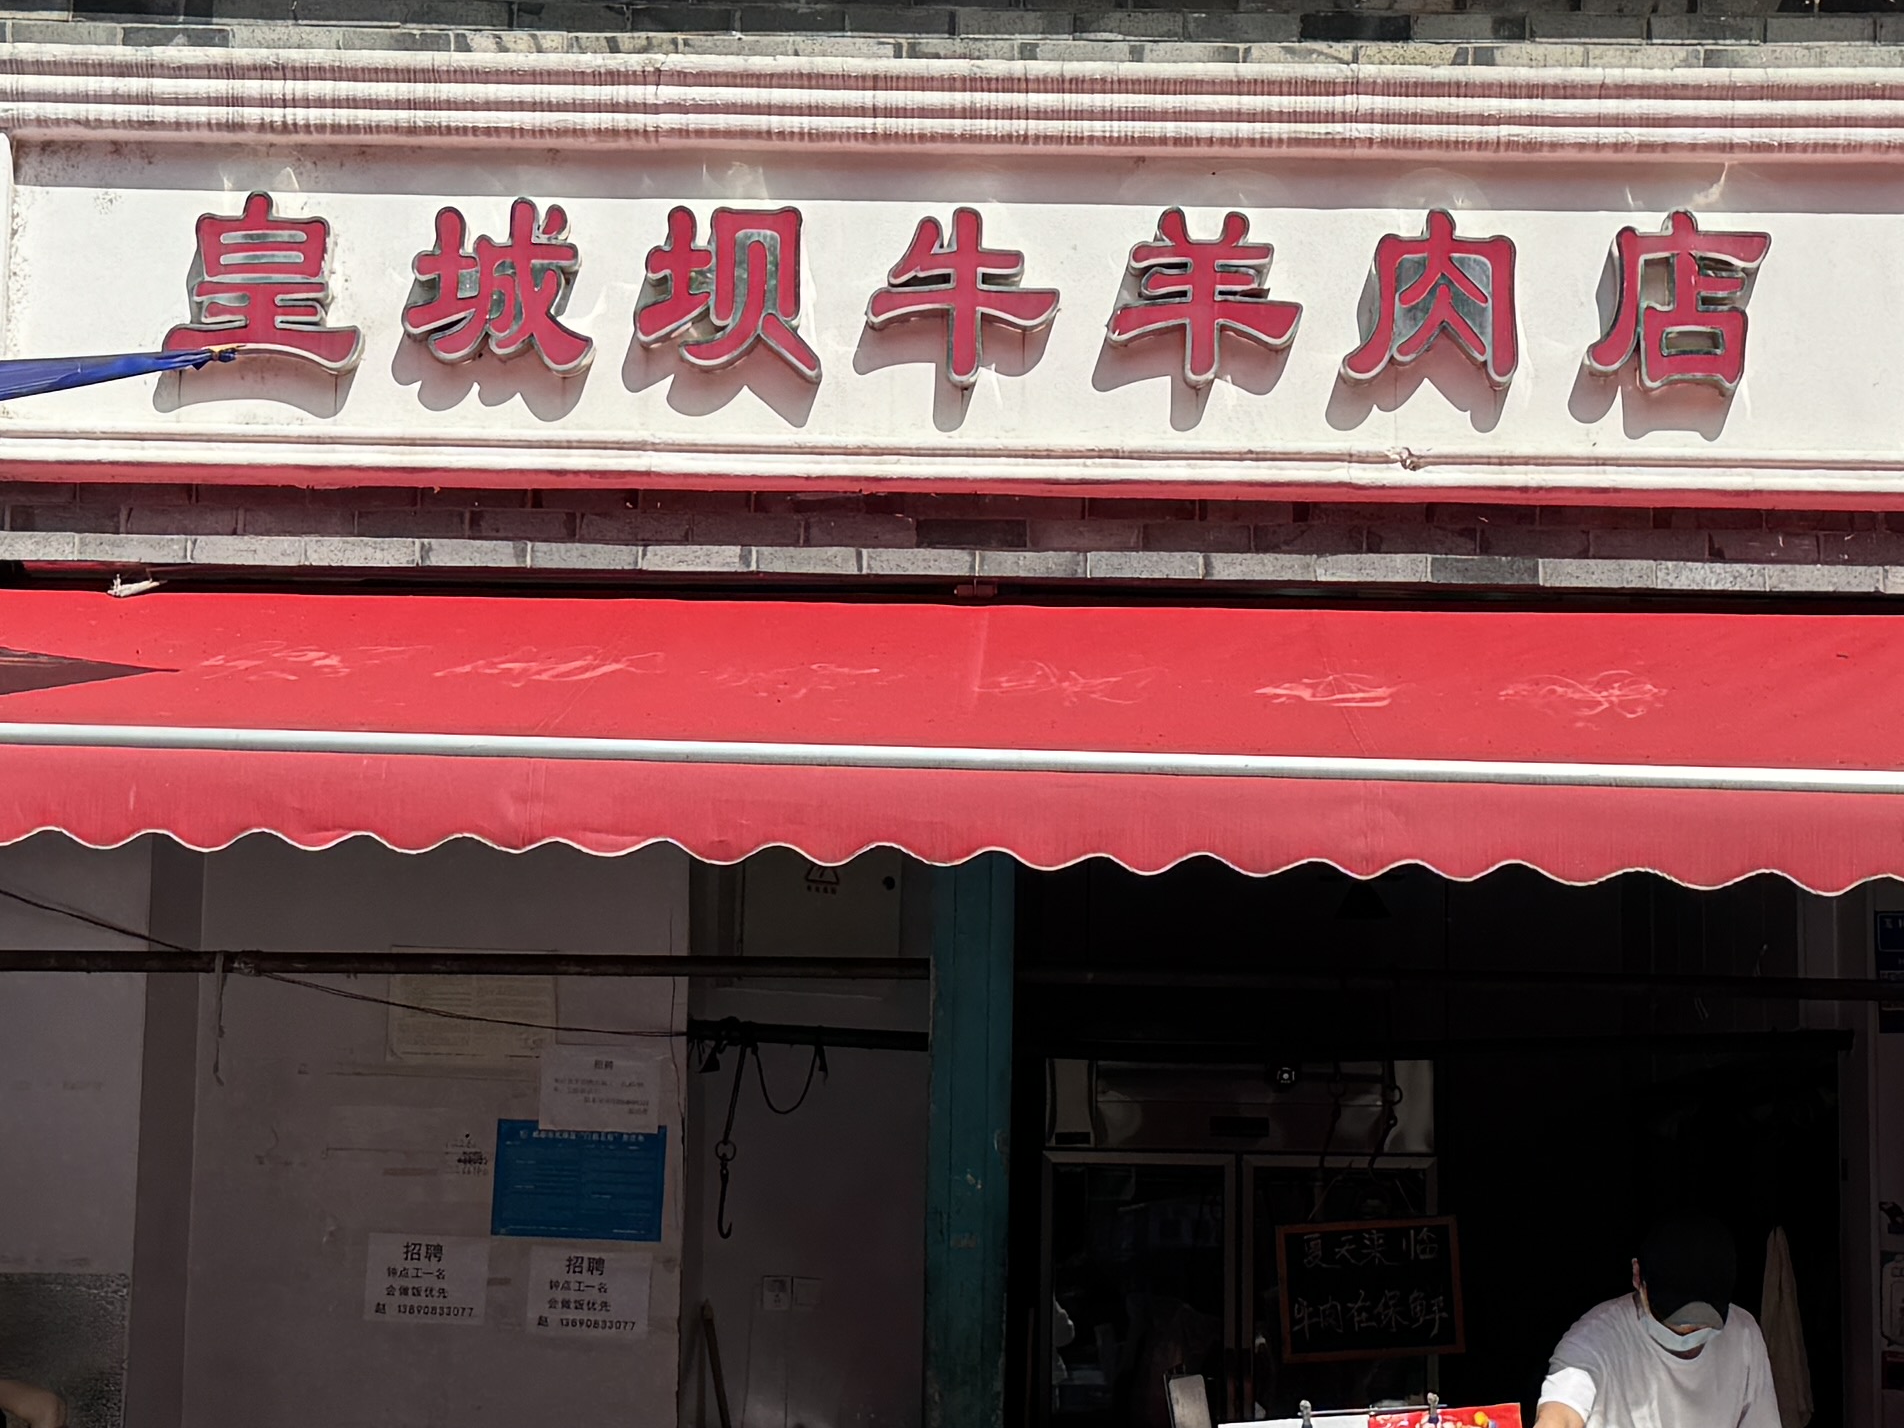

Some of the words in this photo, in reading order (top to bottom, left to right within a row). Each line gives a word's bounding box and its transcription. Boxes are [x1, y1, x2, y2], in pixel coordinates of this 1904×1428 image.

[162, 190, 1772, 398] 皇城坝牛羊肉店
[403, 1241, 444, 1263] 招聘
[565, 1255, 605, 1276] 招聘
